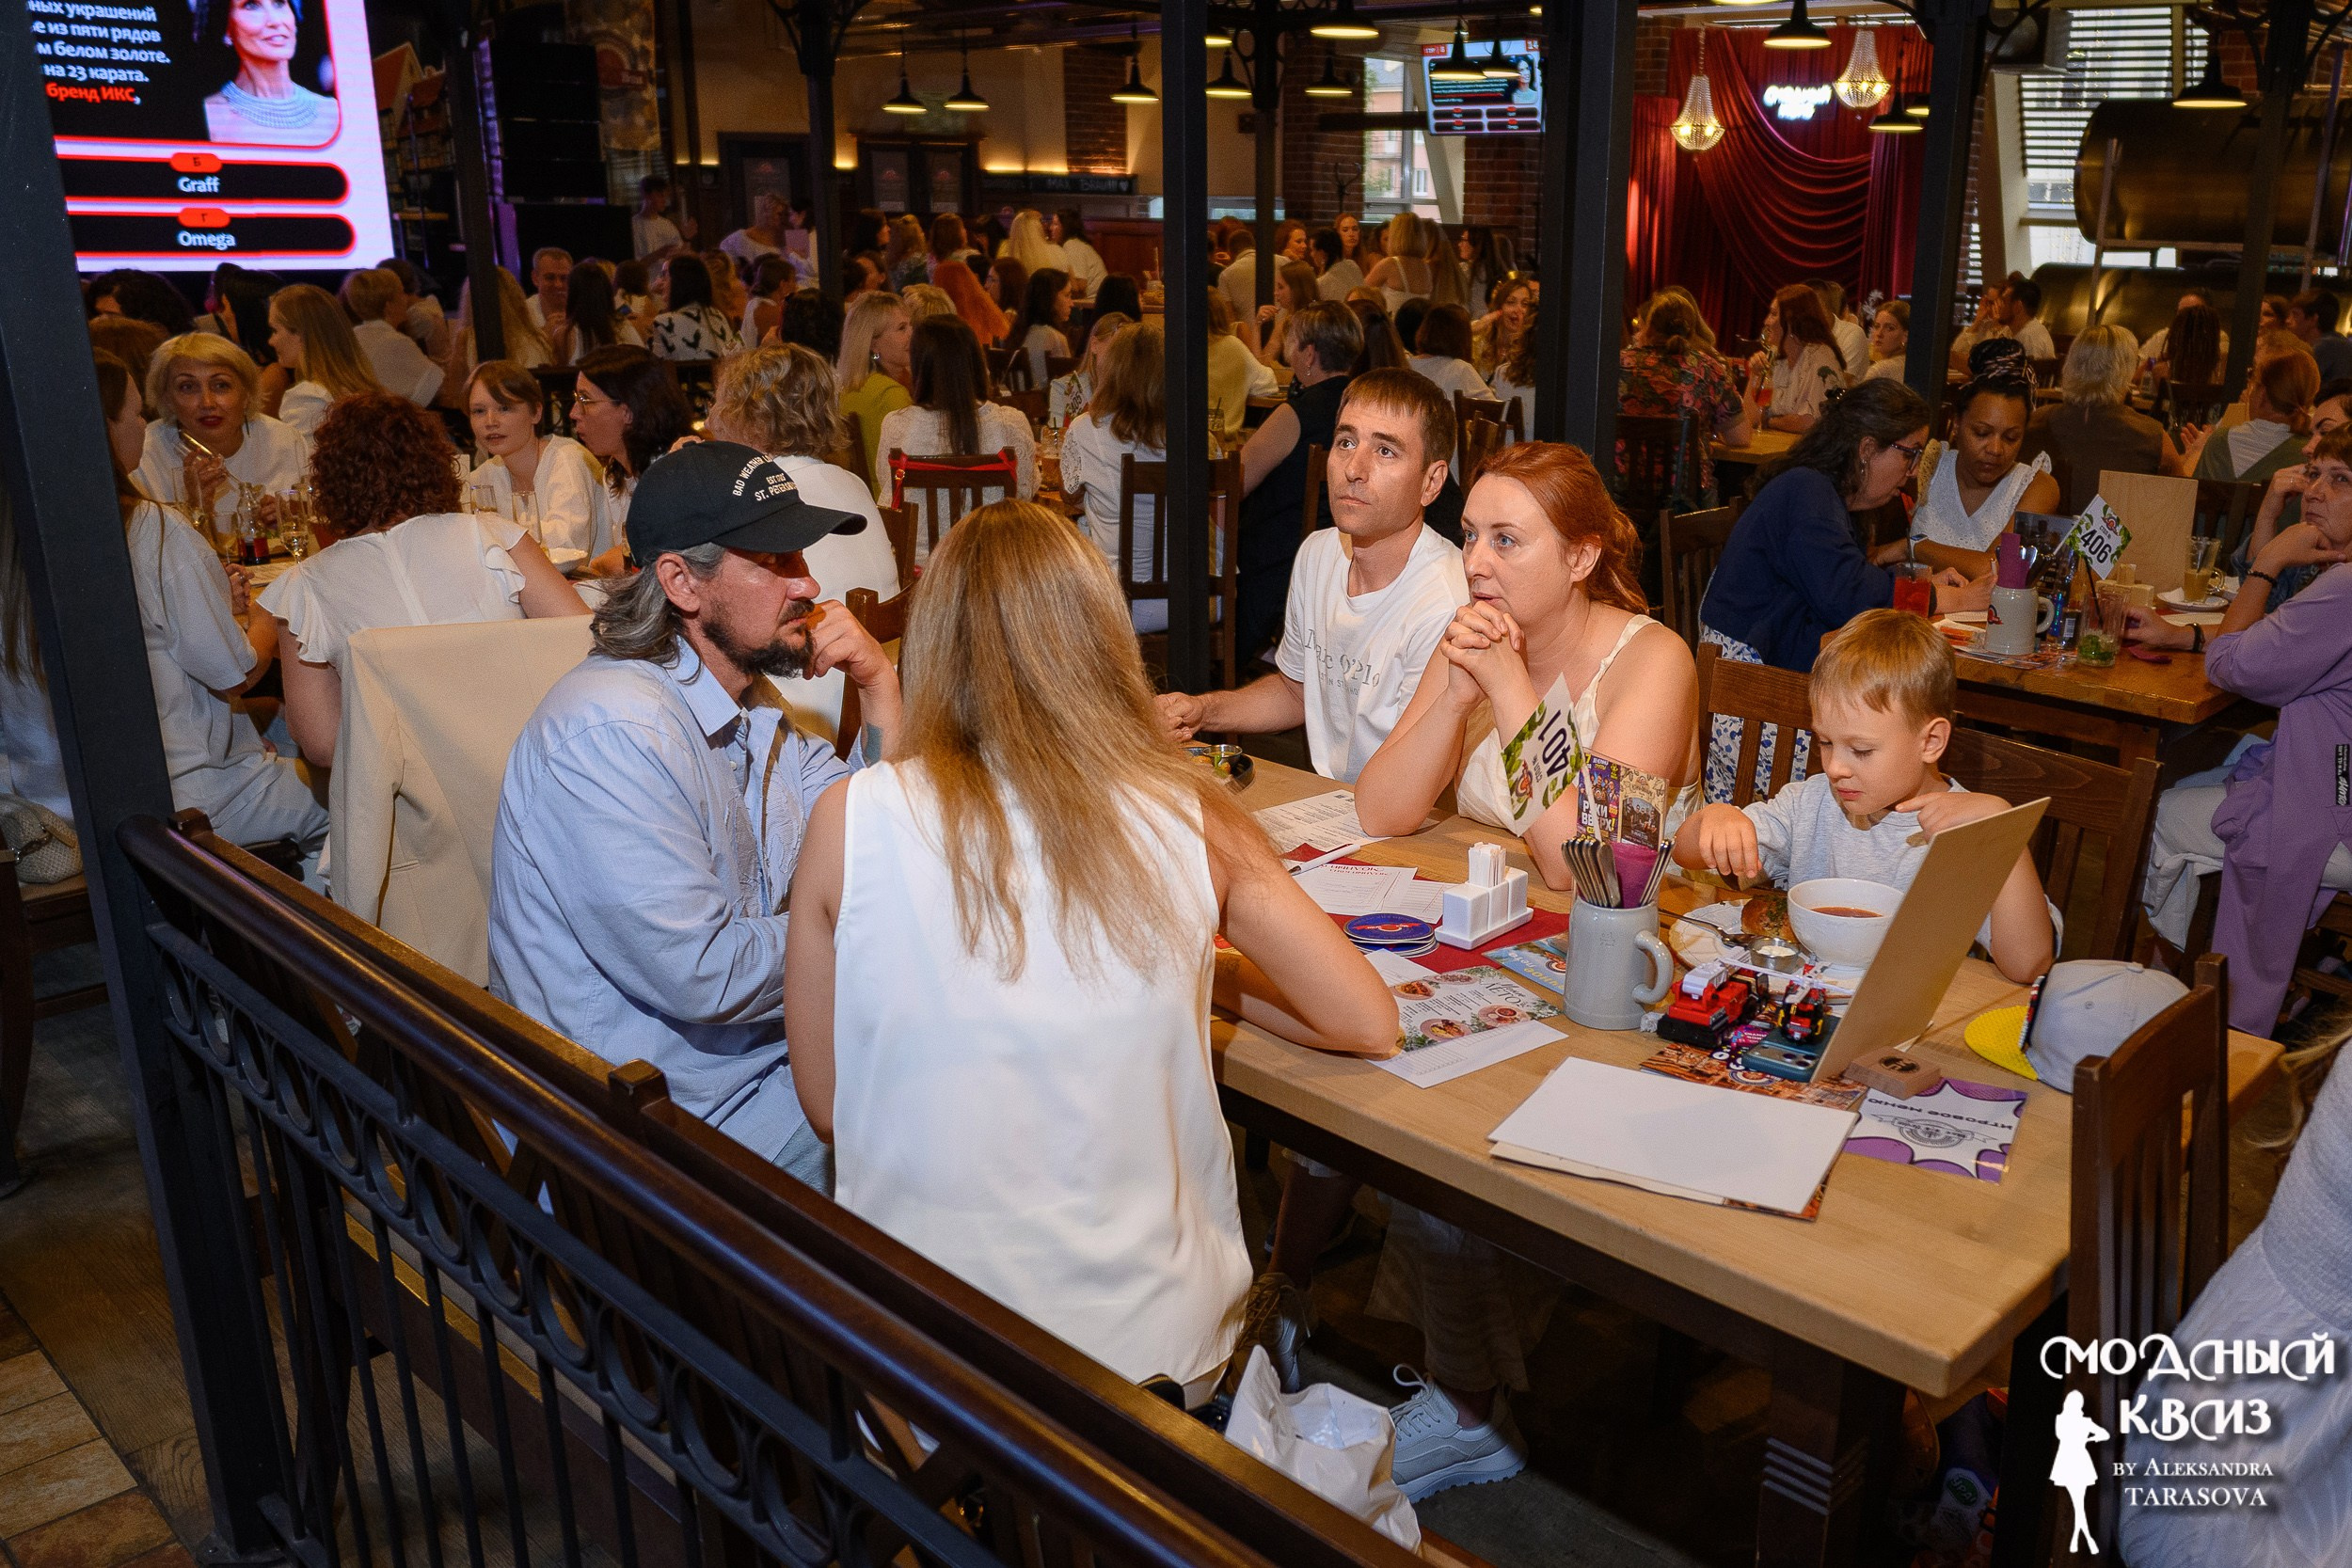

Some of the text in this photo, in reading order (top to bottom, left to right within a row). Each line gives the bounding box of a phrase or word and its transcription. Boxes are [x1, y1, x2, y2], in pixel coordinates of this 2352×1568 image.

[66, 3, 157, 23] украшений
[47, 24, 68, 35] из
[71, 25, 108, 39] пяти
[111, 28, 162, 44] рядов
[54, 41, 108, 59] белом
[110, 49, 171, 64] золоте.
[43, 65, 150, 84] на 23 карата.
[46, 83, 141, 105] бренд ИКС,
[193, 157, 201, 166] Б
[178, 176, 220, 193] Graff
[178, 231, 236, 250] Omega
[733, 480, 745, 497] BAD
[755, 489, 770, 501] ST.
[2080, 529, 2112, 563] 406
[1538, 709, 1571, 778] 401
[1582, 800, 1608, 818] РКИ
[1581, 811, 1616, 832] ВВРХ!
